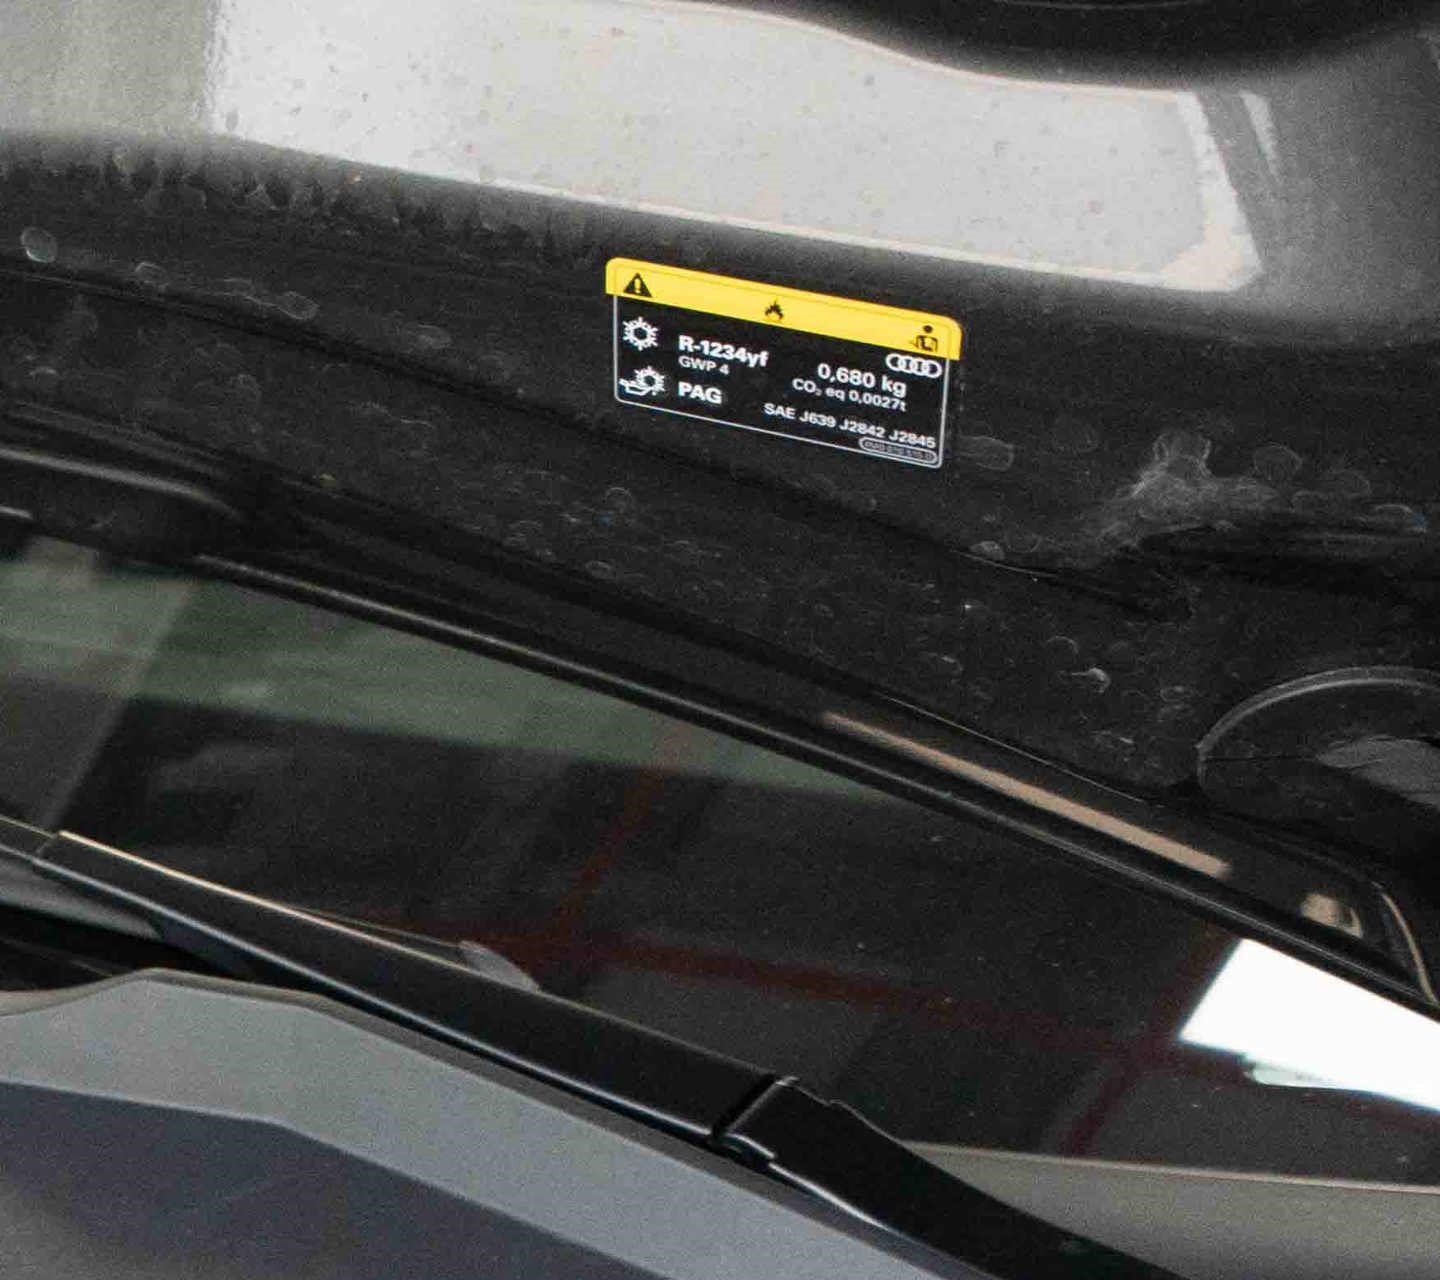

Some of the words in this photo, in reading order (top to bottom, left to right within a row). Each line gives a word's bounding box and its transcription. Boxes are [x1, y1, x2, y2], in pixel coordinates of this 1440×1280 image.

[678, 333, 769, 369] R-1234yf
[678, 355, 717, 372] GWP
[718, 364, 731, 376] 4
[678, 381, 722, 405] PAG
[817, 363, 876, 388] 0,680
[881, 372, 908, 399] kg
[824, 387, 846, 403] eq
[763, 402, 796, 420] SAE
[798, 409, 836, 429] J639
[839, 416, 885, 438] J2842
